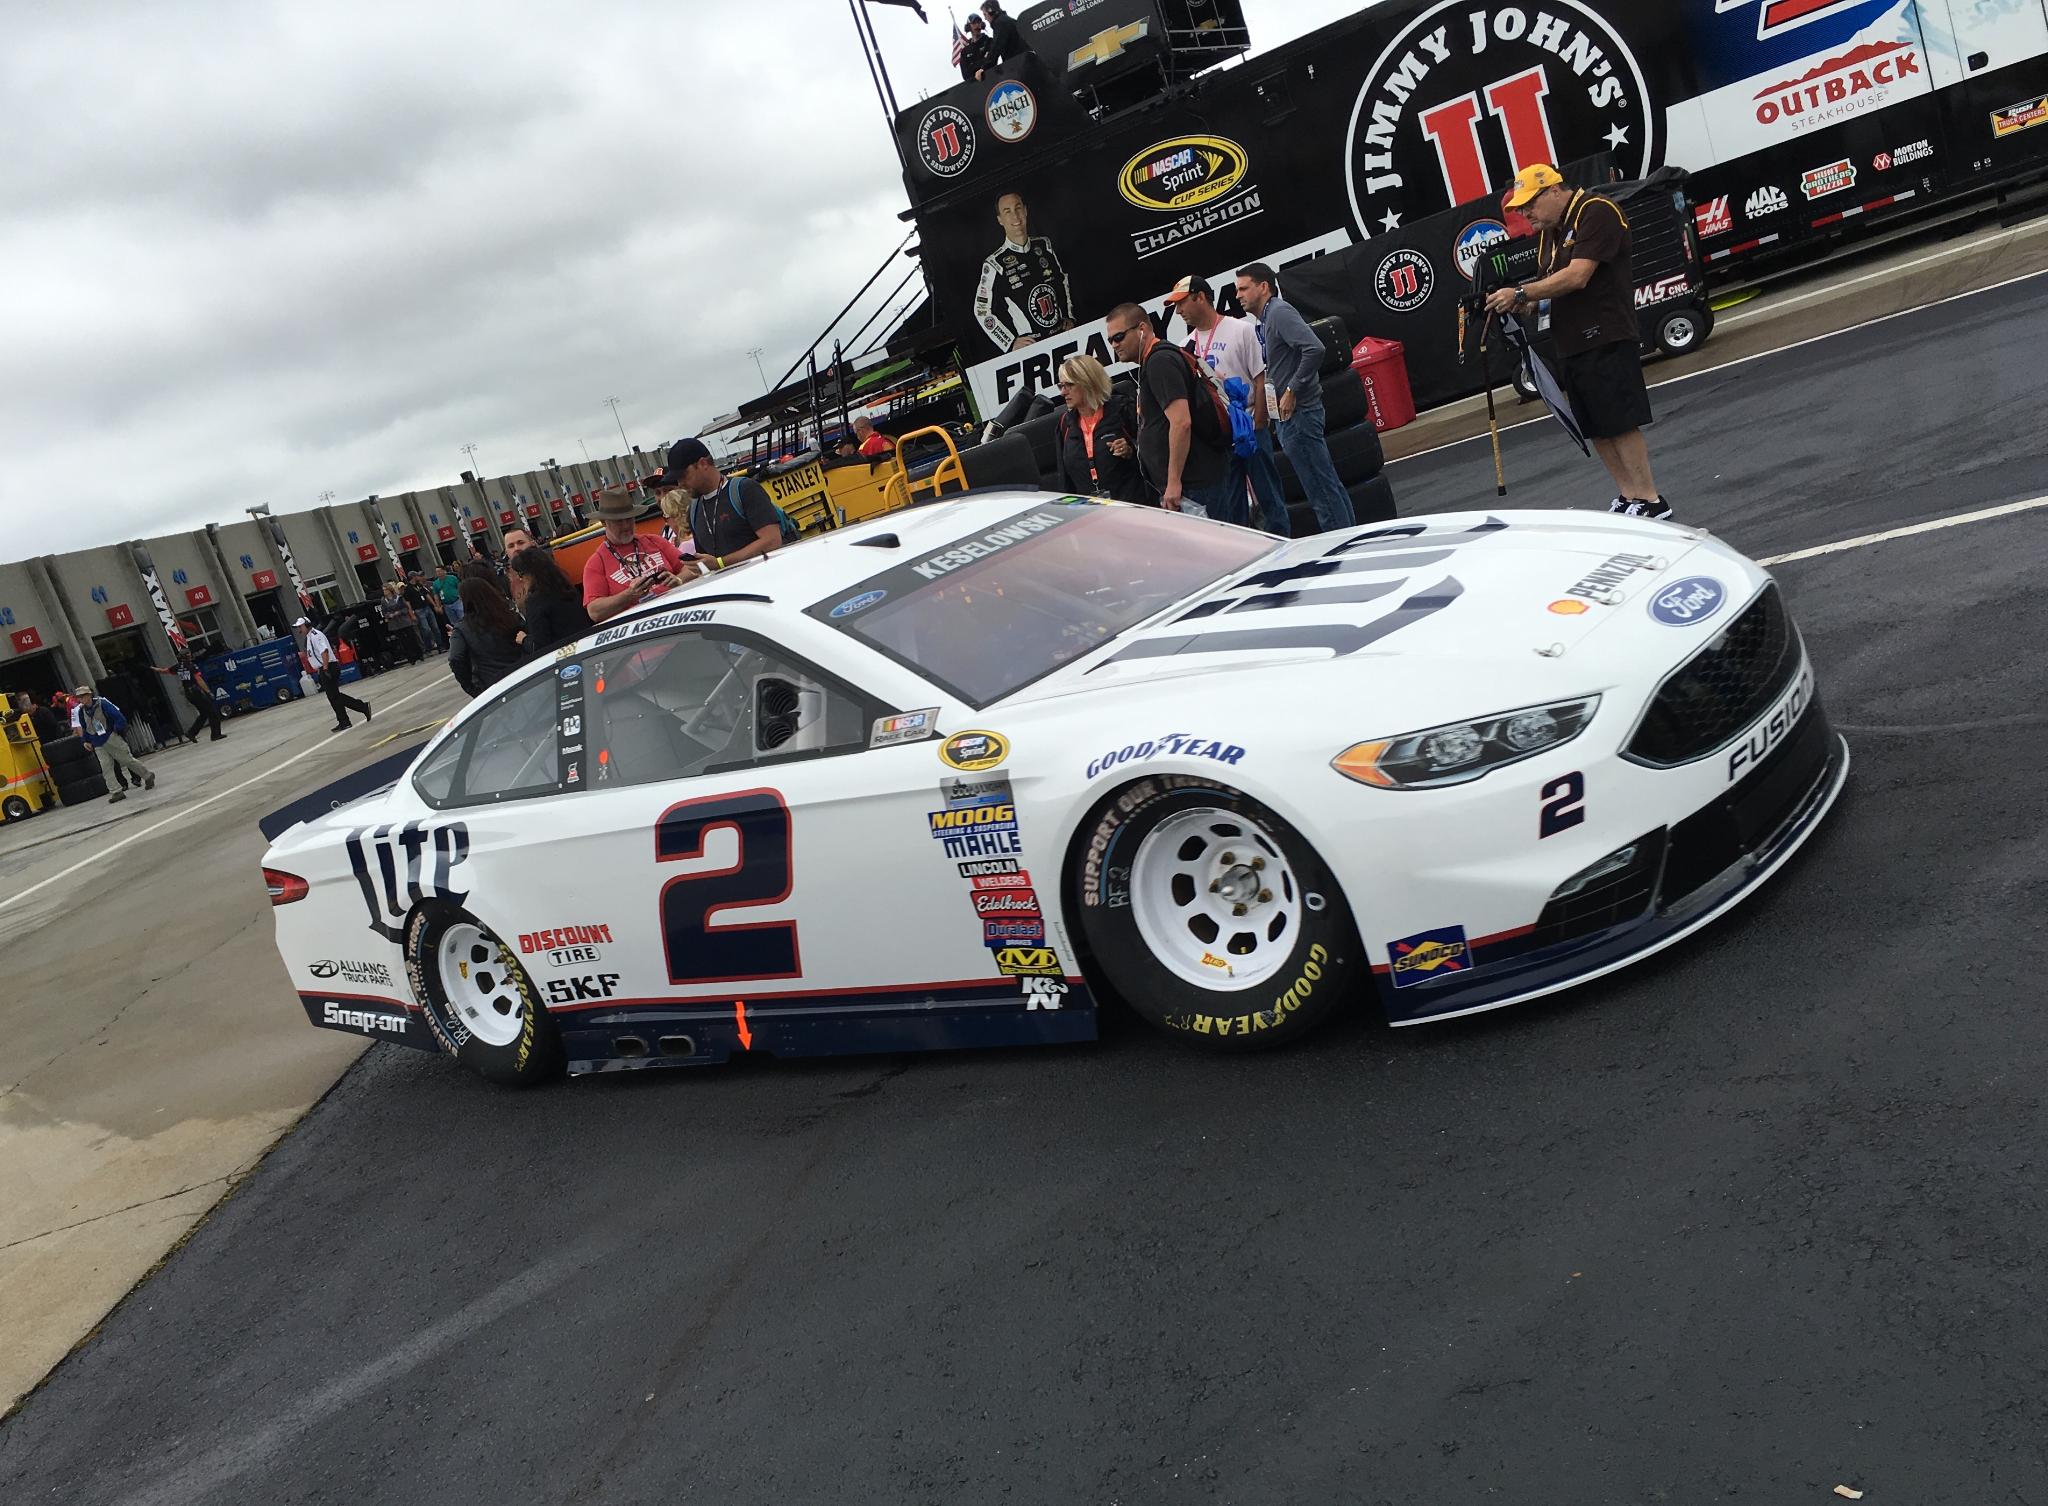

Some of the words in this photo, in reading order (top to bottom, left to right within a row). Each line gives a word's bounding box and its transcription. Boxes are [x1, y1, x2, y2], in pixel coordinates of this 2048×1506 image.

[1032, 10, 1065, 32] OUTBACK
[1365, 25, 1451, 195] JIMMY
[1469, 7, 1624, 109] JOHN'S
[1756, 52, 1920, 126] OUTBACK
[989, 94, 1031, 123] BUSCH
[1791, 91, 1885, 132] STEAKHOUSE
[1998, 116, 2019, 131] TRUCK
[2018, 108, 2046, 124] CENTERS
[921, 113, 937, 152] JIMMY
[938, 110, 970, 133] JOHN'S
[930, 143, 972, 173] SANDWICHES
[1892, 145, 1934, 167] BUILDINGS
[1893, 138, 1929, 158] MORTON
[1152, 149, 1192, 178] NASCAR
[1813, 165, 1840, 180] HUNT
[1162, 163, 1204, 192] Sprint
[1174, 191, 1196, 206] CUP
[1198, 175, 1235, 197] SERIES
[1805, 169, 1852, 190] BROTHERS
[1816, 181, 1844, 194] PIZZA
[1745, 185, 1788, 214] MAC
[1746, 200, 1789, 220] TOOLS
[1134, 192, 1262, 253] CHAMPION
[1178, 207, 1211, 225] 2014
[1379, 256, 1398, 289] JIMMY
[1399, 253, 1429, 274] JOHN'S
[1385, 282, 1430, 308] SANDWICHES
[1668, 282, 1688, 296] CNC
[772, 465, 822, 499] STANLEY
[911, 511, 1065, 581] KESELOWSKI
[260, 575, 270, 584] 39
[1565, 553, 1655, 601] PENNZOIL
[194, 591, 204, 601] 40
[842, 592, 880, 615] Ford
[1658, 583, 1718, 618] Ford
[115, 610, 127, 621] 41
[595, 625, 629, 647] BRAD
[631, 609, 717, 636] KESELOWSKI
[21, 634, 33, 645] 42
[904, 728, 927, 739] CAR
[1086, 734, 1246, 779] GOODYEAR
[932, 805, 1014, 830] MOOG
[1539, 770, 1585, 840] 2
[933, 828, 965, 837] STEERING
[974, 822, 1016, 833] SUSPENSION
[943, 832, 1022, 858] MAHLE
[1084, 808, 1120, 907] SUPPORT
[1117, 780, 1158, 813] OUR
[960, 861, 1018, 877] LINCOLN
[978, 876, 1026, 887] WELDERS
[655, 787, 803, 985] 2
[977, 894, 1039, 912] Edelbrock
[518, 924, 614, 954] DISCOUNT
[988, 923, 1041, 937] Duralast
[340, 960, 390, 977] ALLIANCE
[552, 947, 596, 964] TIRE
[1394, 943, 1465, 972] SUNOCO
[341, 973, 370, 984] TRUCK
[370, 975, 394, 988] PARTS
[547, 973, 621, 1004] SKF
[1193, 943, 1328, 1036] GOODYEAR
[323, 1002, 407, 1033] Snap-on
